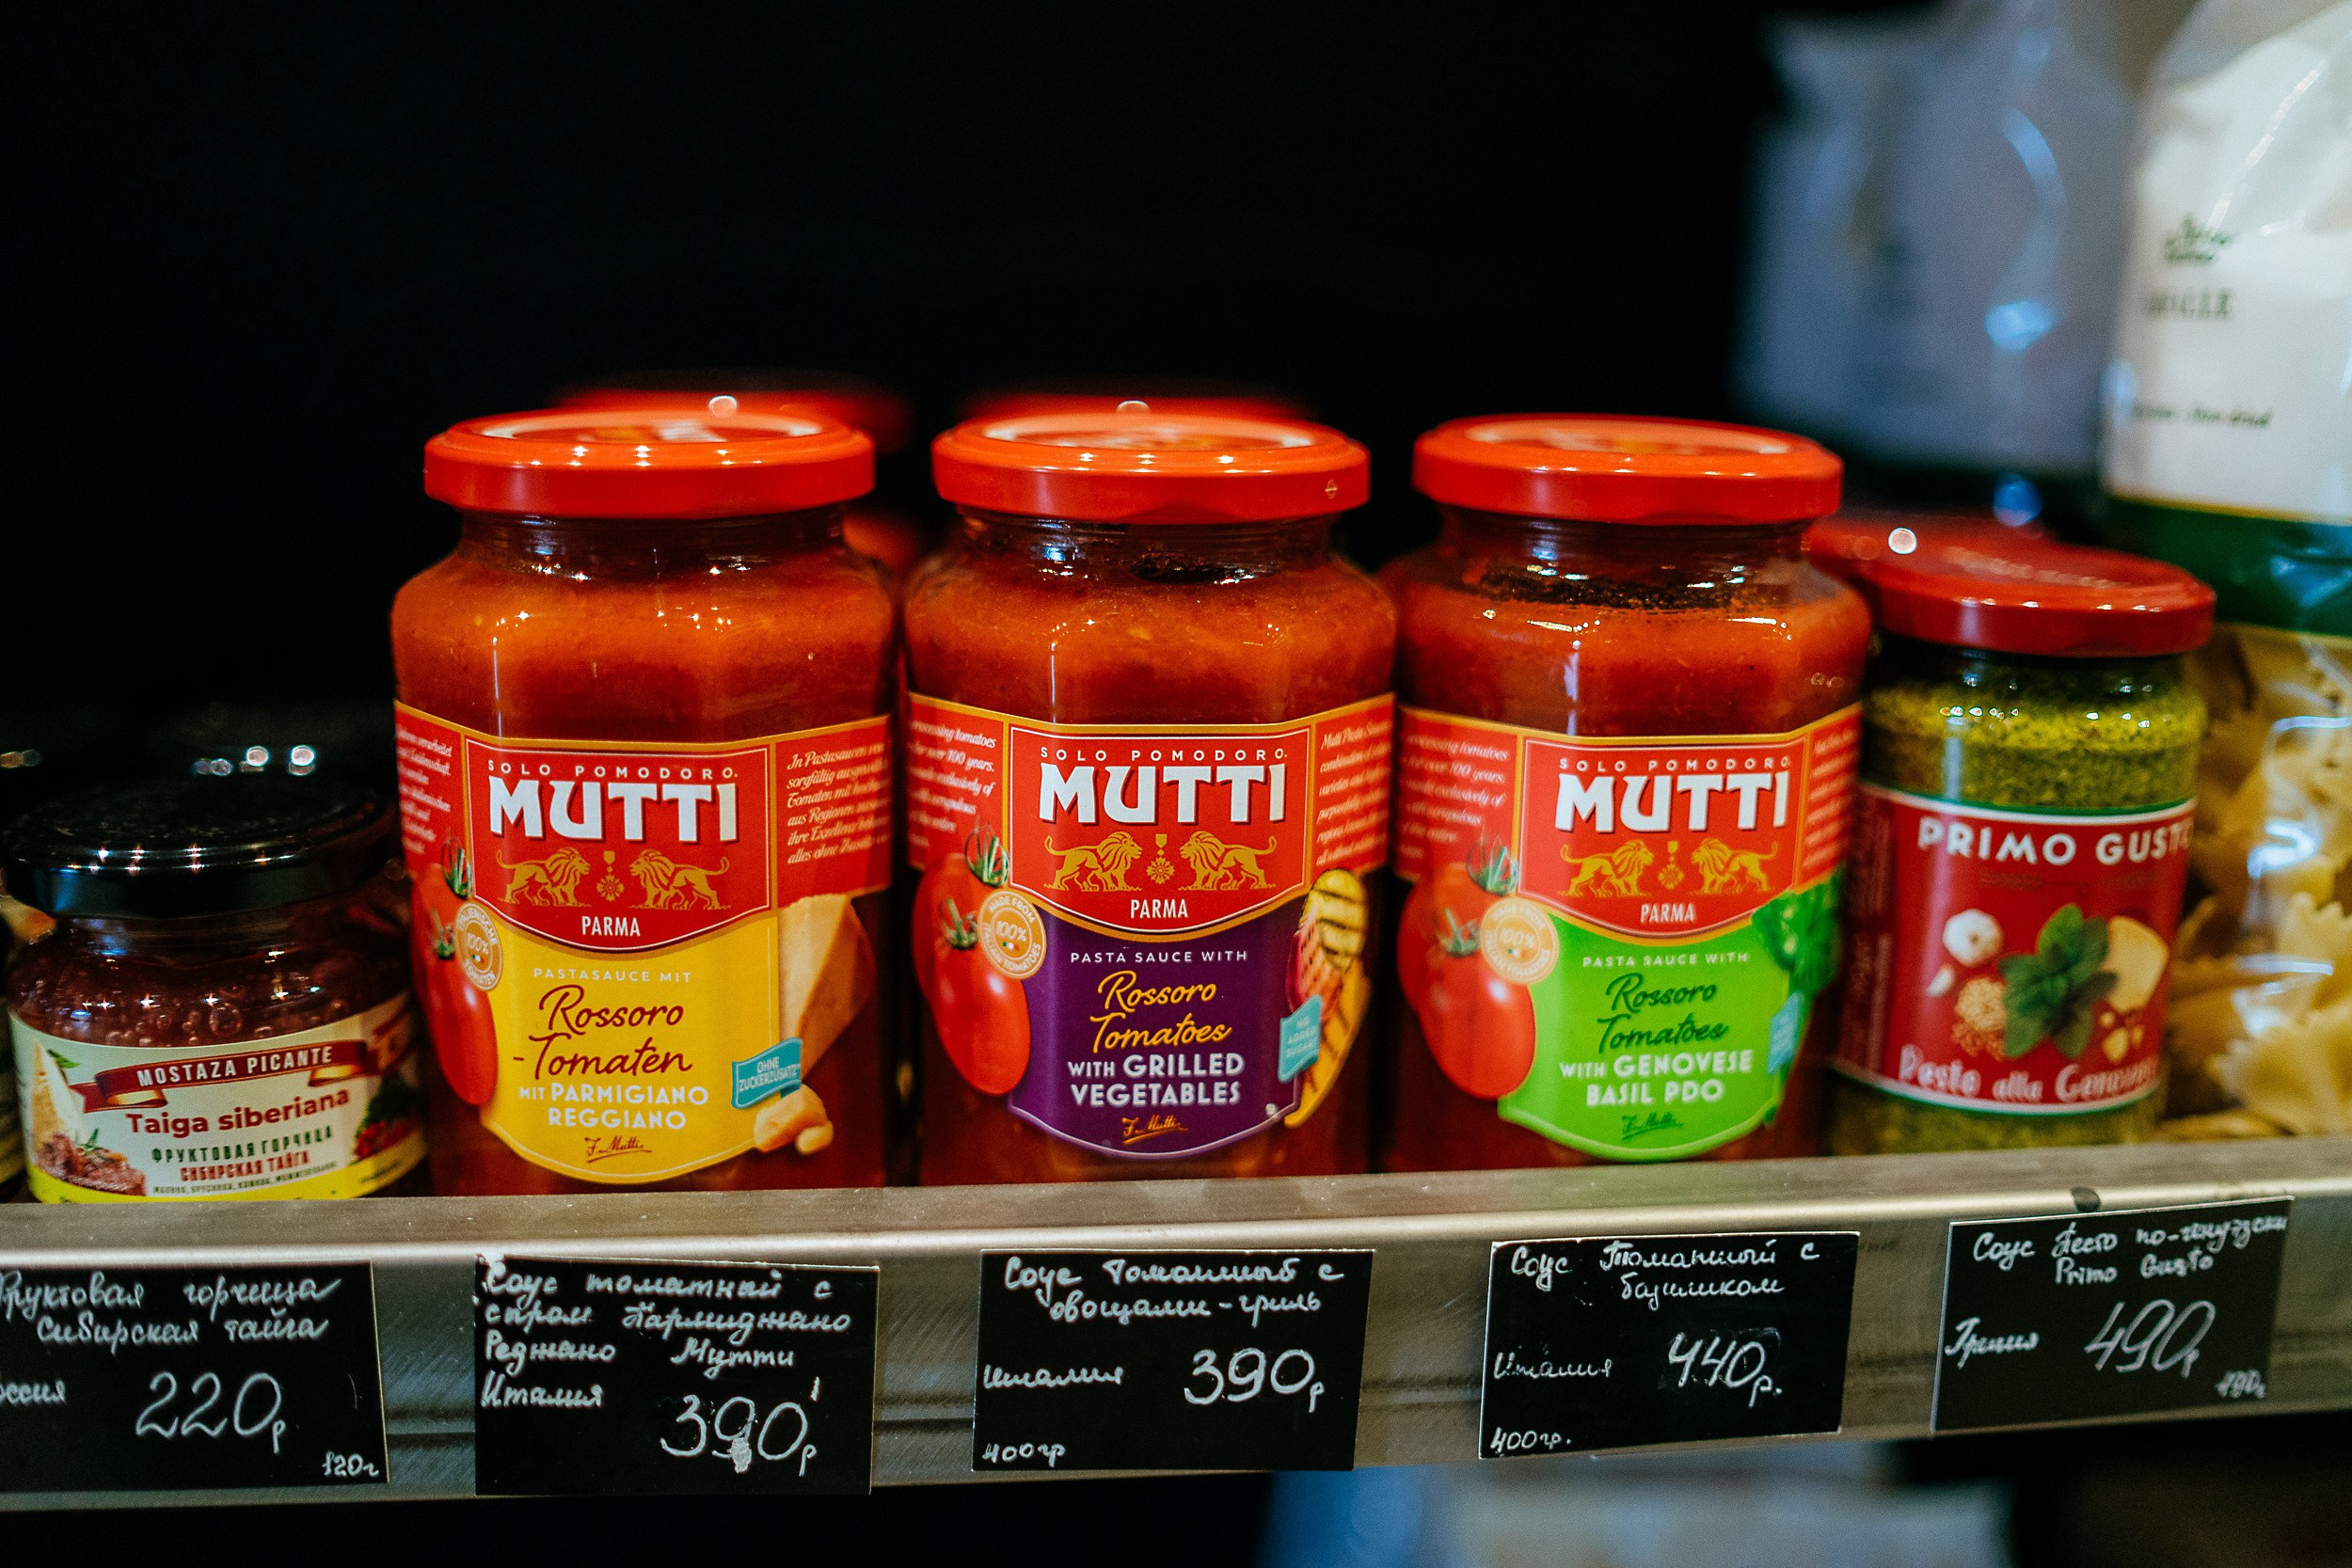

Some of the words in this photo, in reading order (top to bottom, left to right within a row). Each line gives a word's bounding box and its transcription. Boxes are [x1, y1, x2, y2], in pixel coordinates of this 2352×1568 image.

[955, 728, 997, 749] tomatoes
[1041, 746, 1107, 762] SOLO
[487, 759, 551, 775] SOLO
[1560, 757, 1626, 772] SOLO
[488, 775, 739, 843] MUTTI
[1039, 763, 1287, 825] MUTTI
[1554, 769, 1788, 832] MUTTI
[1917, 816, 2077, 865] PRIMO
[580, 915, 641, 938] PARMA
[989, 896, 1011, 912] MADE
[1011, 897, 1036, 924] FROM
[1130, 898, 1188, 920] PARMA
[1640, 902, 1696, 925] PARMA
[996, 920, 1027, 942] 100%
[533, 967, 650, 983] PASTASAUCE
[660, 970, 691, 983] MIT
[1071, 950, 1127, 963] PASTA
[1135, 951, 1192, 963] SAUCE
[1201, 949, 1248, 962] WITH
[1582, 954, 1636, 968] PASTA
[1643, 953, 1697, 967] SAUCE
[1704, 951, 1750, 965] WITH
[538, 985, 684, 1036] Rossoro
[1097, 970, 1217, 1013] Rossoro
[1605, 972, 1717, 1014] Rossoro
[1089, 1012, 1232, 1053] Tomatoes
[1597, 1013, 1729, 1053] Tomatoes
[136, 1059, 236, 1087] MOSTAZA
[246, 1045, 334, 1075] PICANTE
[513, 1034, 692, 1080] -Tomaten
[756, 1055, 780, 1074] OHNE
[1067, 1060, 1116, 1078] WITH
[1122, 1053, 1245, 1078] GRILLED
[1559, 1060, 1605, 1078] WITH
[1613, 1049, 1754, 1078] GENOVESE
[1899, 1043, 1981, 1099] Pesto
[1992, 1069, 2043, 1102] alla
[519, 1086, 546, 1101] MIT
[550, 1083, 709, 1105] PARMIGIANO
[1071, 1081, 1241, 1108] VEGETABLES
[1585, 1079, 1652, 1107] BASIL
[1663, 1078, 1724, 1103] PDO
[125, 1112, 209, 1138] Taiga
[218, 1089, 350, 1131] siberiana
[548, 1107, 687, 1130] REGGIANO
[151, 1141, 255, 1164] ФРУКТОВАЯ
[261, 1125, 333, 1158] ГОРЧИЦА
[180, 1159, 263, 1181] СИБИРСКАЯ
[267, 1149, 310, 1176] ТАЙГА
[1511, 1245, 1571, 1292] Соус
[1800, 1242, 1820, 1261] с
[1974, 1232, 2035, 1271] Соус
[2055, 1257, 2118, 1285] Primo
[2139, 1246, 2215, 1279] Gusto
[484, 1261, 558, 1309] Соус
[814, 1279, 833, 1299] с
[1005, 1256, 1083, 1307] Соус
[1317, 1261, 1345, 1281] с
[37, 1310, 199, 1356] Сибирская
[670, 1337, 795, 1379] Мутти
[0, 1379, 67, 1406] оссия
[480, 1370, 604, 1409] Италия
